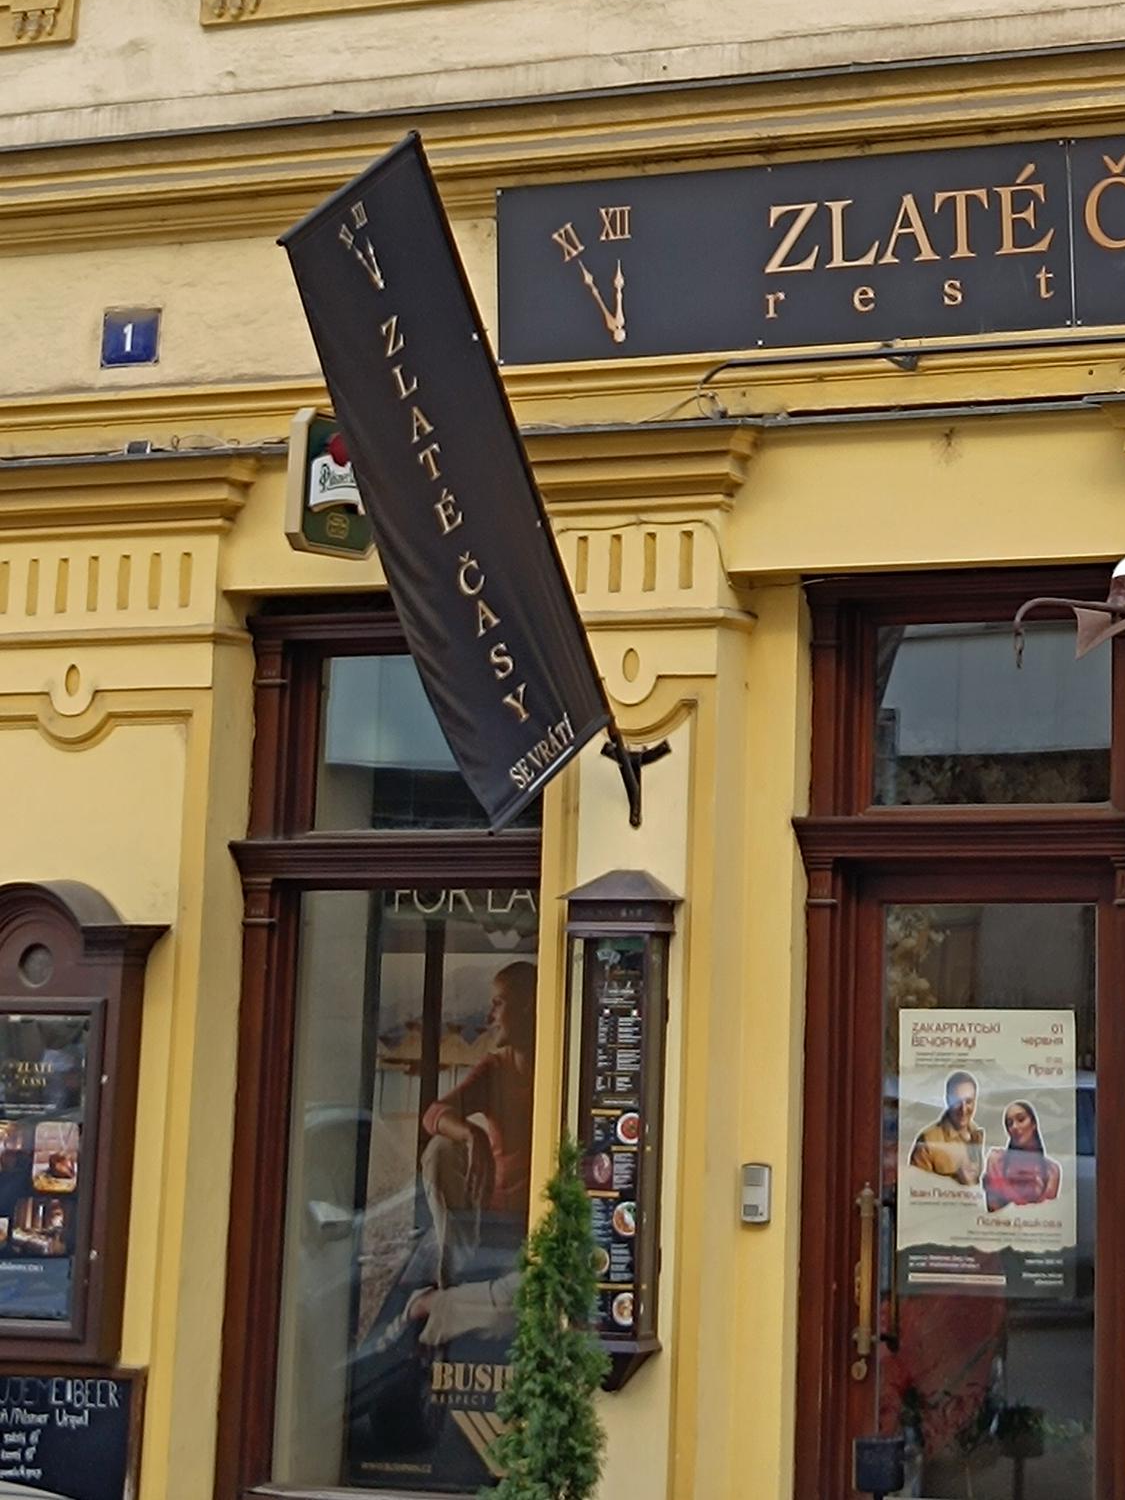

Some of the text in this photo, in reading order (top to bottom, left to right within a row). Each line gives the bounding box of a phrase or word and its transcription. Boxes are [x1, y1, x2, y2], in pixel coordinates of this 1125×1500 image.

[599, 205, 632, 242] XII
[764, 162, 1055, 274] ZLATÉ
[123, 322, 133, 353] 1
[380, 313, 529, 723] ZLATÉ ČASY
[509, 711, 575, 789] SE VRÁTÍ
